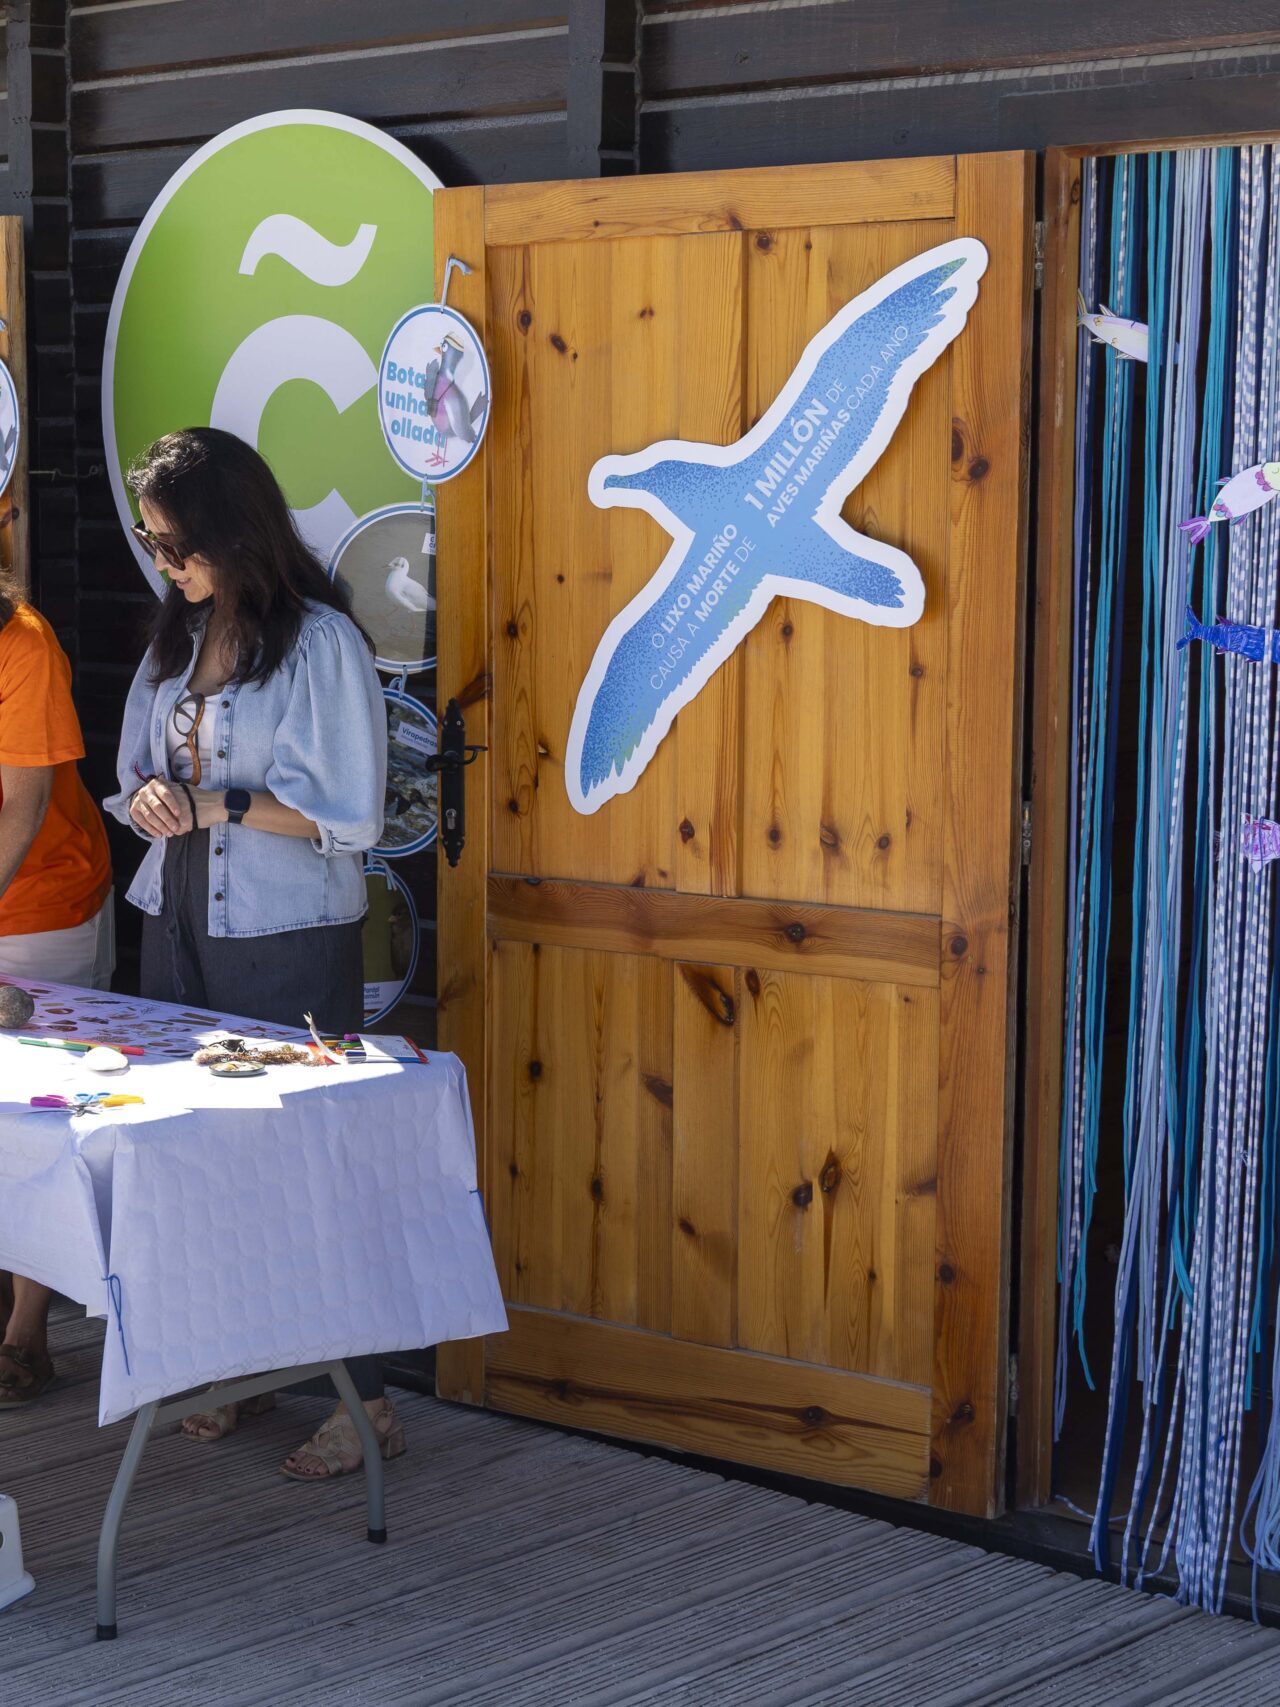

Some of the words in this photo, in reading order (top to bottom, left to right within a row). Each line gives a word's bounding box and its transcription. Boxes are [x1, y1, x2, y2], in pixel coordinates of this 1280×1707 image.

[385, 391, 429, 417] unha
[387, 361, 427, 389] Bota
[391, 419, 446, 448] ollada
[767, 483, 799, 528] AVES
[794, 409, 850, 486] MARIÑAS
[847, 365, 884, 409] CADA
[880, 326, 908, 364] ANO
[744, 493, 764, 510] 1
[755, 398, 829, 497] MILLÓN
[825, 378, 847, 403] DE
[651, 637, 690, 690] CAUSA
[687, 622, 701, 637] A
[694, 560, 740, 622] MORTE
[734, 536, 757, 562] DE
[652, 633, 664, 648] O
[661, 594, 691, 634] LIXO
[687, 524, 737, 595] MARIÑO
